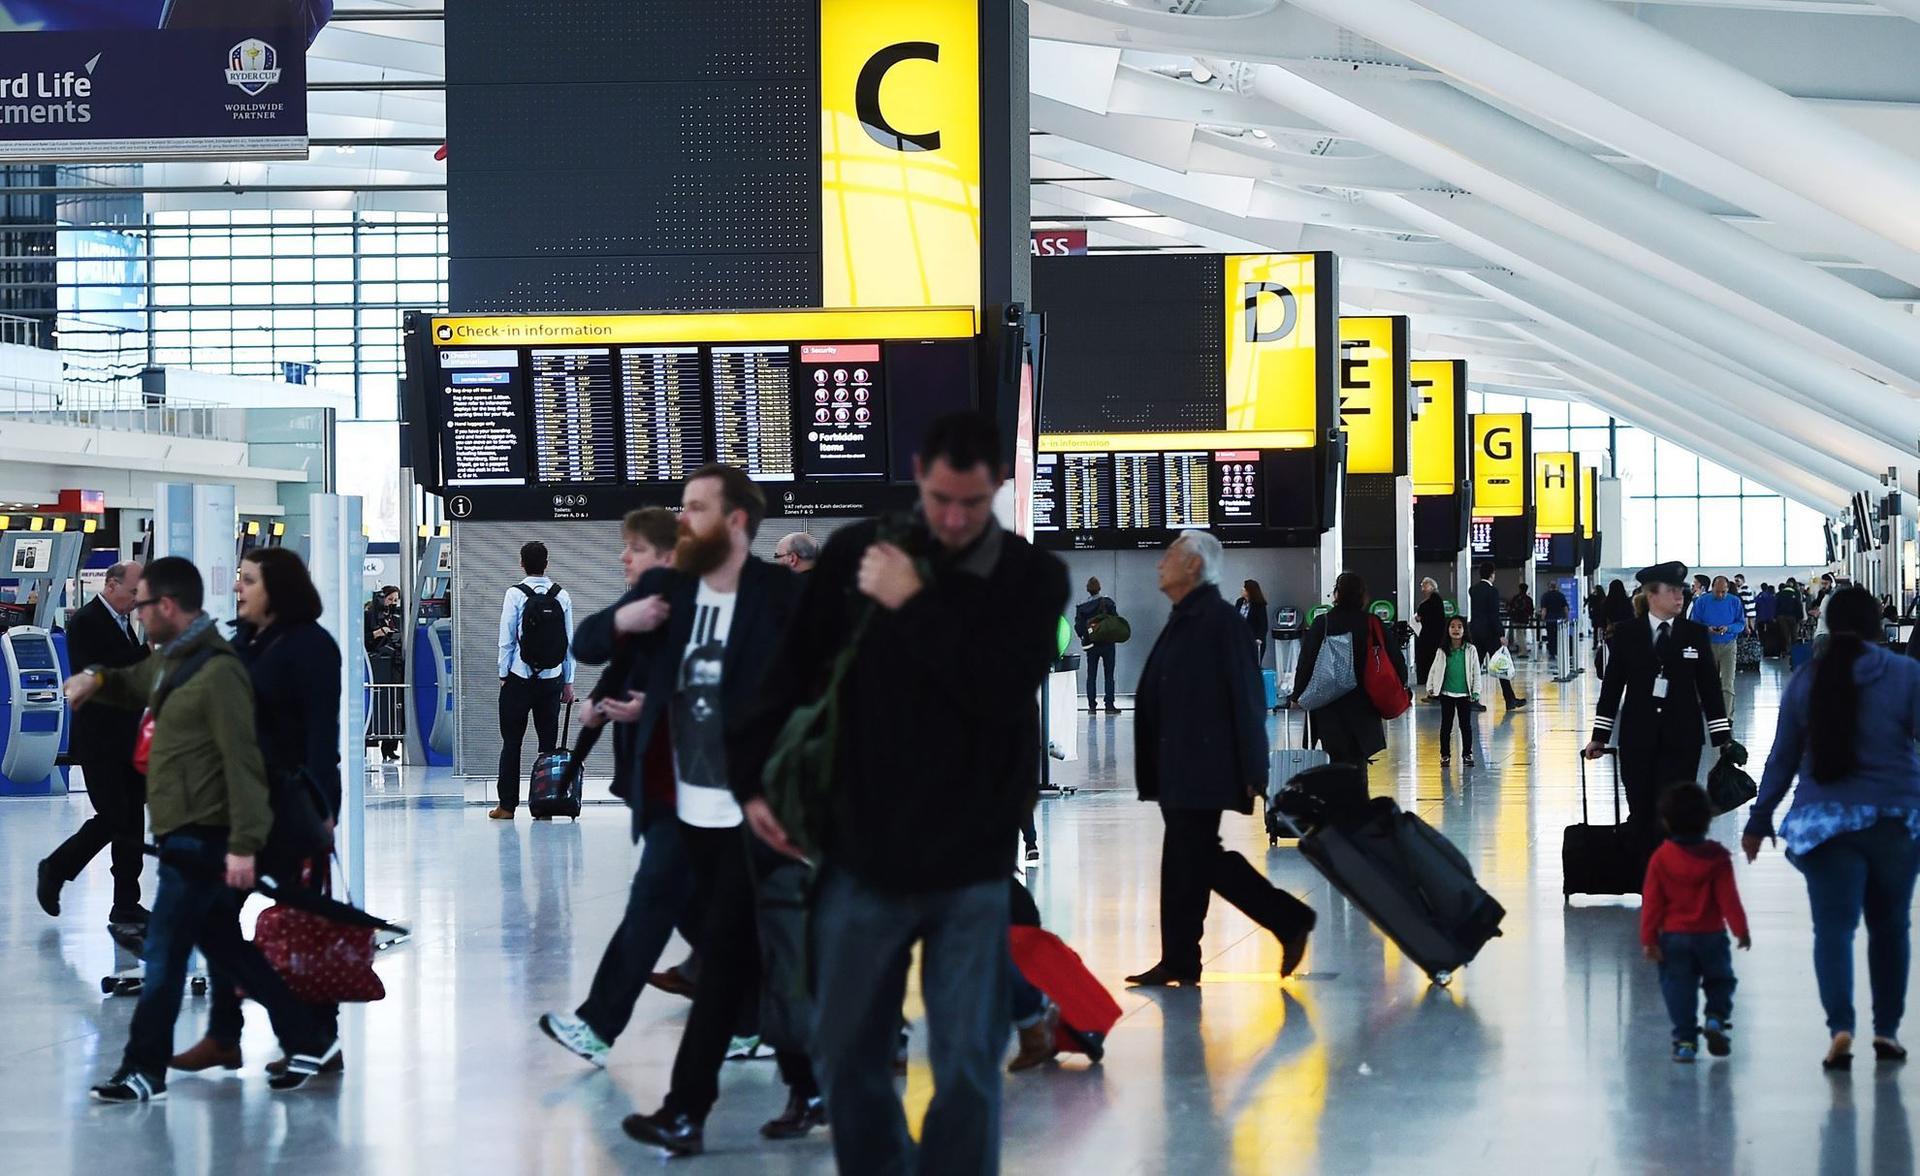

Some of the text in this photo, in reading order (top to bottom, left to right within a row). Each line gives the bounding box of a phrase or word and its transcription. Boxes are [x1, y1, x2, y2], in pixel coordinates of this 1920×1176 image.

[37, 71, 91, 98] Life
[258, 72, 277, 80] CUP
[855, 41, 941, 152] C
[233, 112, 276, 120] PARTNER
[1244, 282, 1297, 342] D
[456, 323, 612, 337] Check-in information
[1341, 340, 1370, 388] E
[1484, 427, 1512, 460] G
[1545, 464, 1564, 488] H
